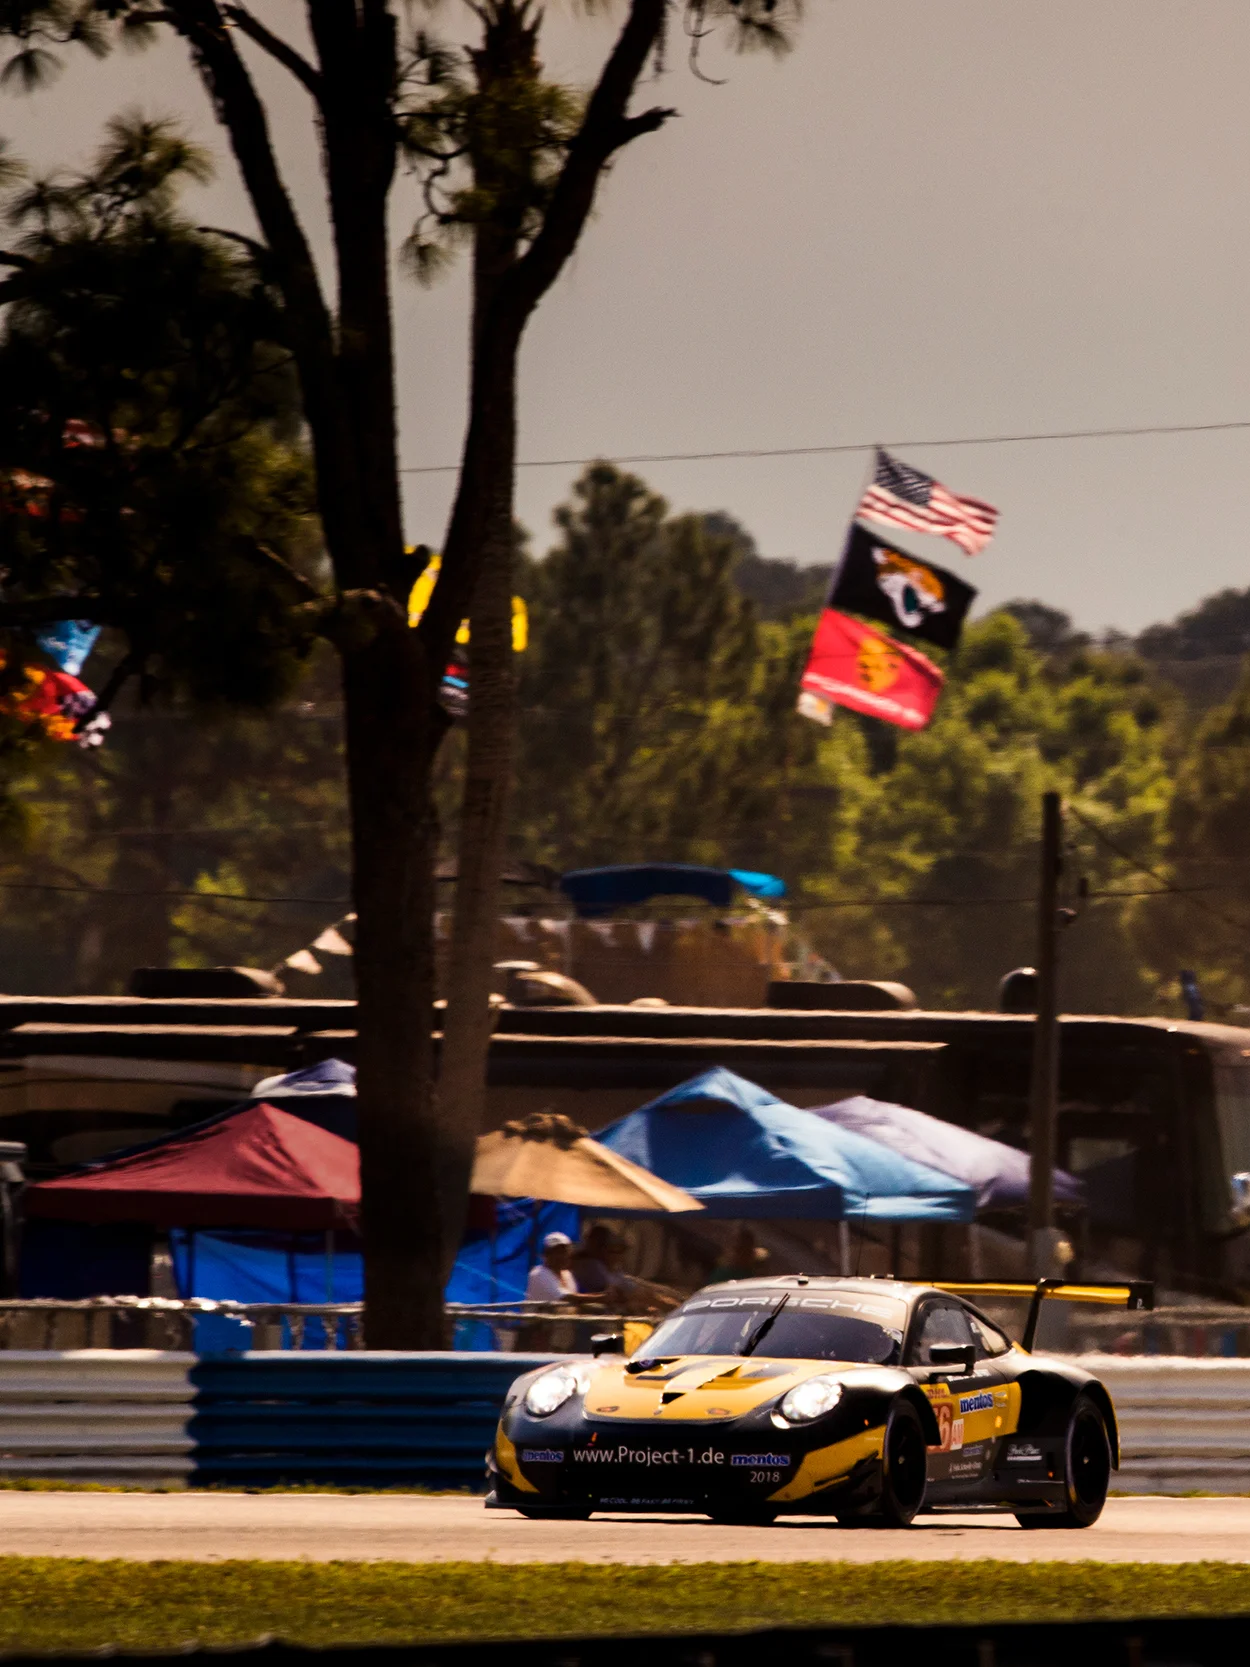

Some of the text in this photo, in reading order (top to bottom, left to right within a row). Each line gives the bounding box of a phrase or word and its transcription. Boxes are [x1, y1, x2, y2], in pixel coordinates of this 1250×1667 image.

[683, 1296, 893, 1318] PORSCHE
[960, 1391, 994, 1414] mentos
[522, 1449, 564, 1462] mentos
[573, 1445, 791, 1467] www.Project-1.de mentos
[750, 1471, 780, 1483] 2018
